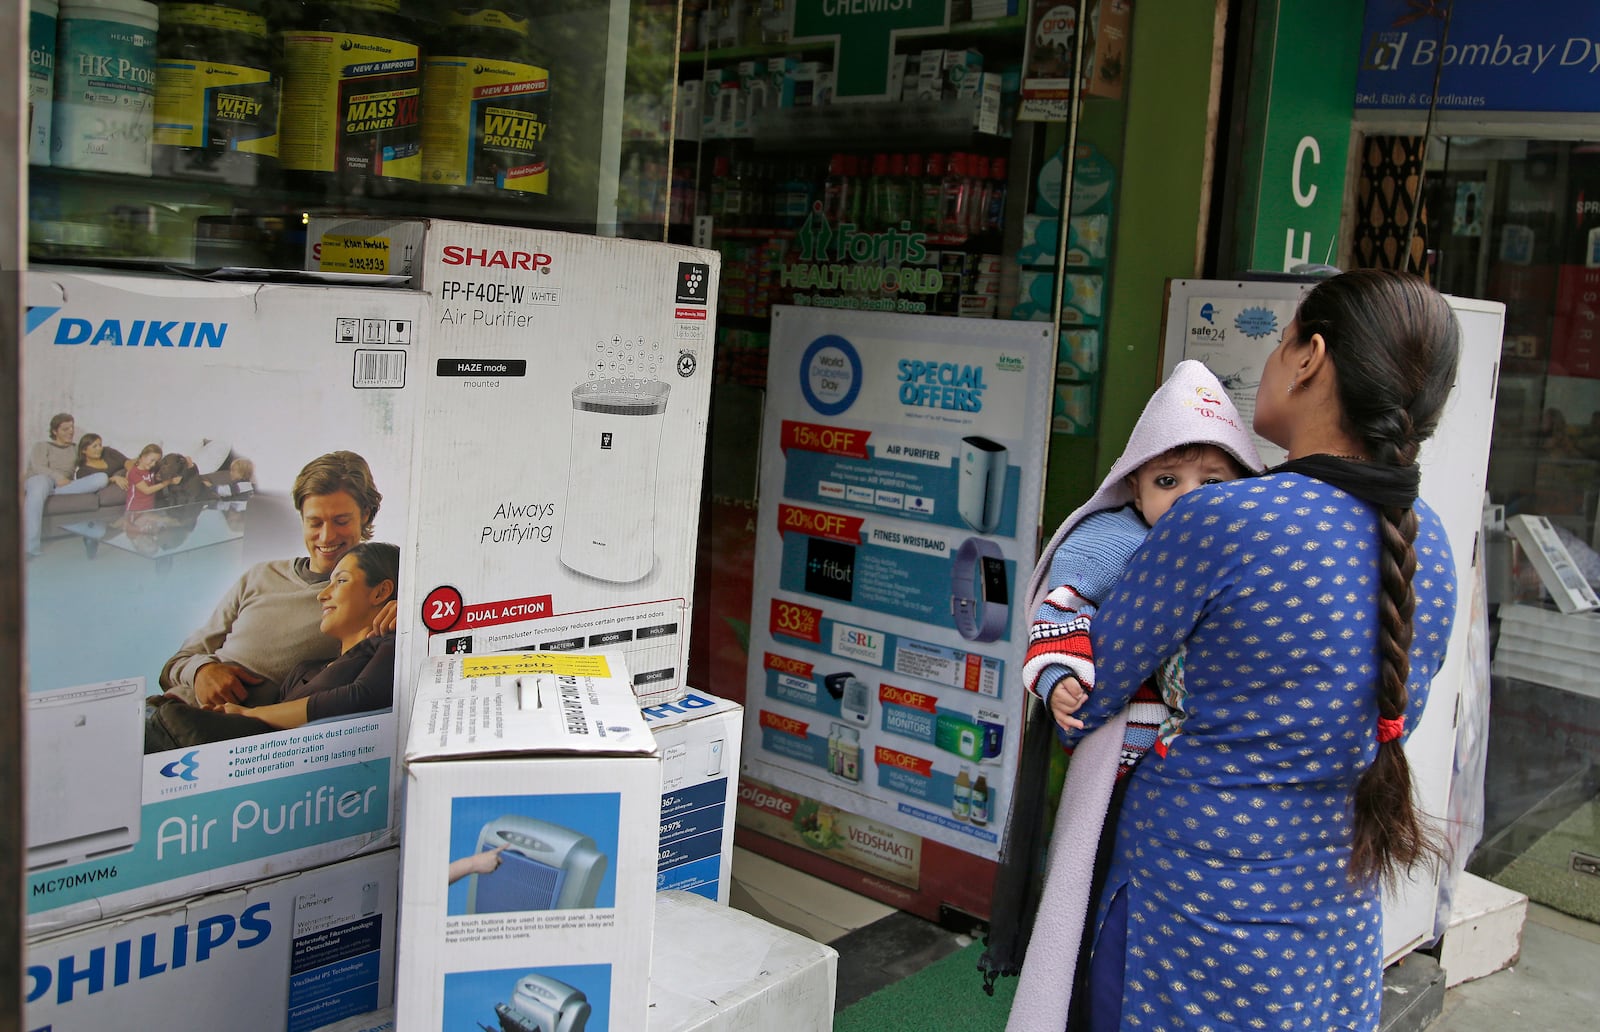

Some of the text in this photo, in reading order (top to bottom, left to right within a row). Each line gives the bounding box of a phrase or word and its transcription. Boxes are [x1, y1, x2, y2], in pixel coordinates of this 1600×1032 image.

[1411, 34, 1554, 74] Bombay
[79, 54, 112, 78] HK
[352, 62, 373, 73] NEW
[381, 60, 415, 71] IMPROVED
[481, 87, 502, 96] NEW
[512, 81, 546, 93] IMPROVED
[217, 97, 262, 115] WHEY
[1380, 92, 1404, 106] Bath
[1407, 93, 1415, 105] &
[216, 110, 246, 120] ACTIVE
[347, 100, 397, 122] MASS
[346, 118, 394, 133] GAINER
[484, 114, 547, 142] WHEY
[482, 135, 533, 150] PROTEIN
[1577, 202, 1600, 214] SPR
[837, 220, 928, 262] Fortis
[441, 246, 552, 271] SHARP
[780, 263, 943, 294] HEALTHWORLD
[442, 281, 557, 304] FP-F40E-W WHITE
[813, 295, 858, 309] Complete
[861, 298, 896, 312] Health
[897, 301, 927, 313] Store
[440, 308, 534, 328] Air Purifier
[54, 318, 229, 348] DAIKIN
[457, 363, 507, 373] HAZE mode
[820, 356, 844, 368] World
[812, 368, 851, 380] Diabetes
[897, 358, 988, 391] SPECIAL
[463, 380, 500, 389] mounted
[821, 378, 840, 393] Day
[899, 385, 983, 413] OFFERS
[793, 426, 857, 450] 15% OFF
[887, 445, 941, 461] AIR PURIFIER
[493, 502, 554, 520] Always
[785, 508, 847, 534] 20% OFF
[481, 523, 553, 545] Purifying
[874, 529, 900, 544] FITNESS
[903, 534, 946, 552] WRISTBAND
[823, 559, 852, 583] fitbit
[431, 600, 456, 620] 2X
[467, 602, 545, 623] DUAL ACTION
[488, 611, 664, 644] Plasmacluster Technology reduces certain germs and odors
[800, 622, 814, 633] OFF
[602, 634, 620, 642] ODORS
[848, 632, 877, 650] SRL
[839, 642, 876, 660] Diagnostics
[786, 660, 807, 672] OFF
[883, 687, 926, 706] 20% OFF
[783, 718, 801, 731] OFF
[887, 716, 931, 736] MONITORS
[235, 723, 379, 756] Large airflow for quick dust collection
[235, 745, 324, 767] Powerful deodorization
[235, 745, 375, 779] Quiet operation Long lasting filter
[895, 752, 919, 768] OFF
[160, 784, 197, 796] STREAMER
[739, 783, 793, 814] Colgate
[662, 797, 674, 808] 367
[157, 786, 377, 861] Air Purifier
[848, 826, 914, 861] VEDSHAKTI
[33, 866, 118, 896] MC70MVM6
[298, 897, 334, 911] Luftreiniger
[306, 938, 341, 953] Deutschland
